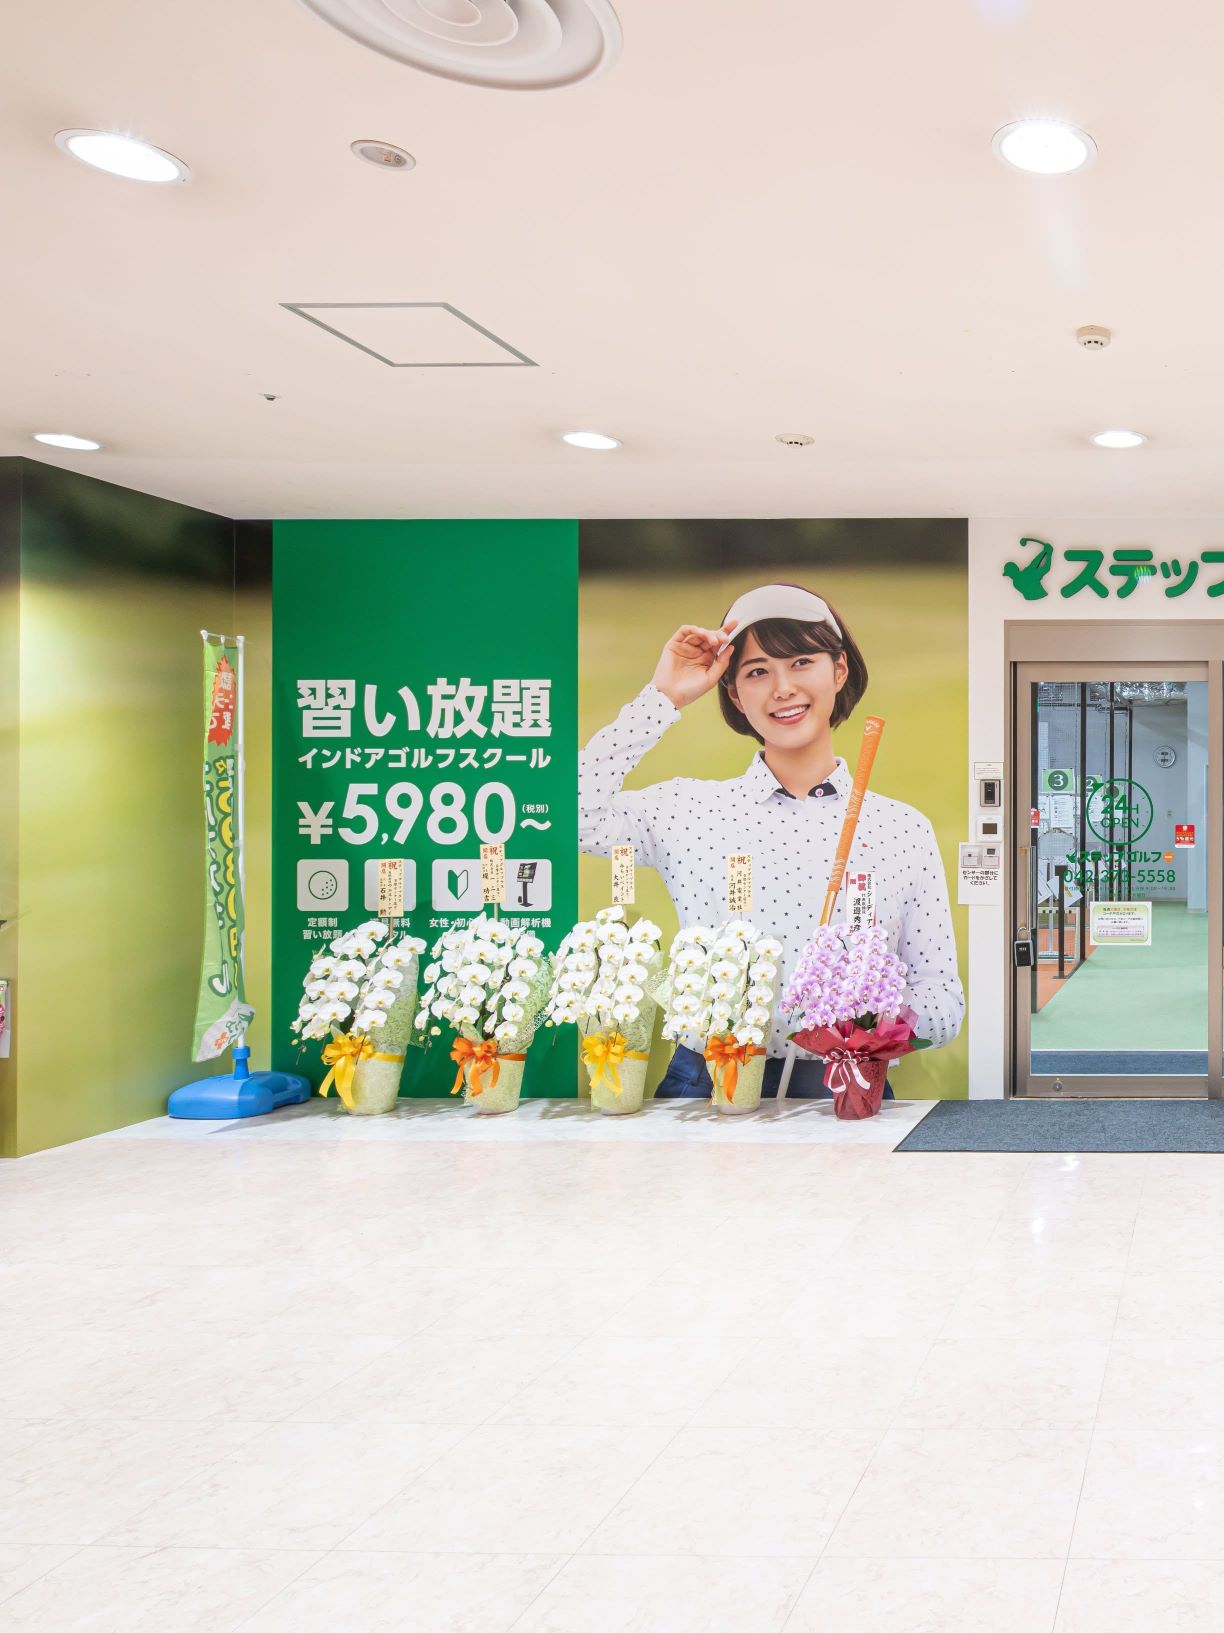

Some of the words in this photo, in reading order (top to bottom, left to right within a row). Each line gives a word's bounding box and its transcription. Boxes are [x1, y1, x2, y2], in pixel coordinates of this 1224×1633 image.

[296, 677, 552, 738] 習い放題
[298, 747, 552, 769] インドアゴルフスクール
[1053, 774, 1064, 787] 3
[1086, 779, 1094, 789] 2
[1101, 817, 1139, 828] OPEN
[1081, 851, 1162, 863] ステップゴルフ
[1063, 869, 1176, 883] 042-373-5558
[307, 917, 338, 928] 定額制
